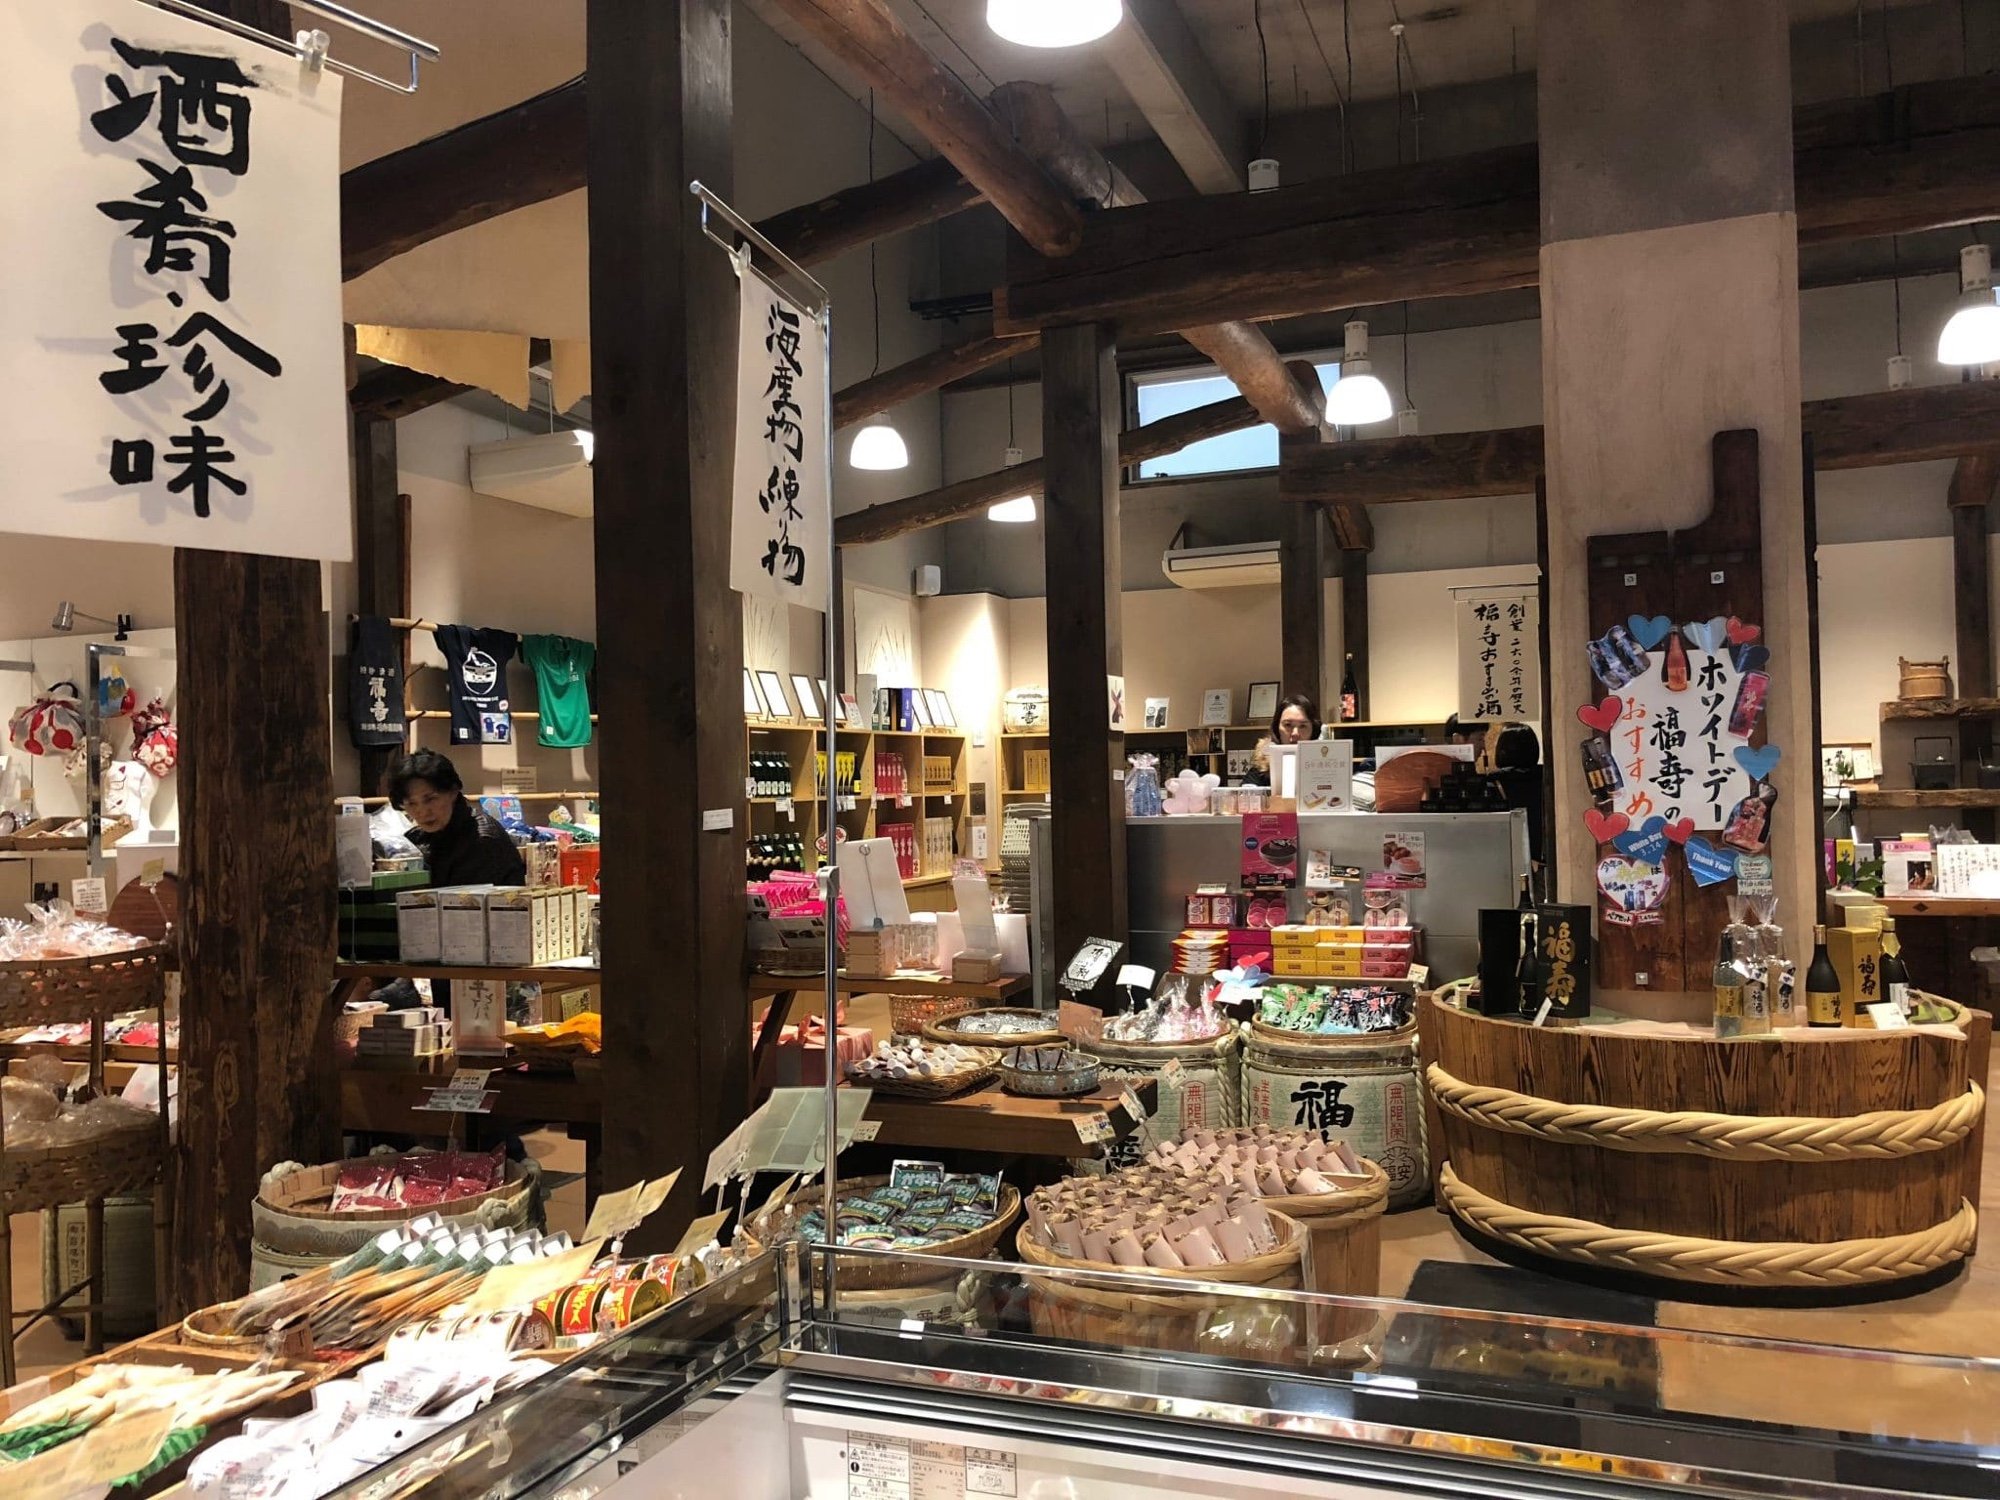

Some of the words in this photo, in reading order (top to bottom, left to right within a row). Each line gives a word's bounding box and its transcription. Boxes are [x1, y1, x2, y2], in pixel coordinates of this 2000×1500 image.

[1621, 696, 1654, 819] おすすめ
[1692, 851, 1715, 867] Thank
